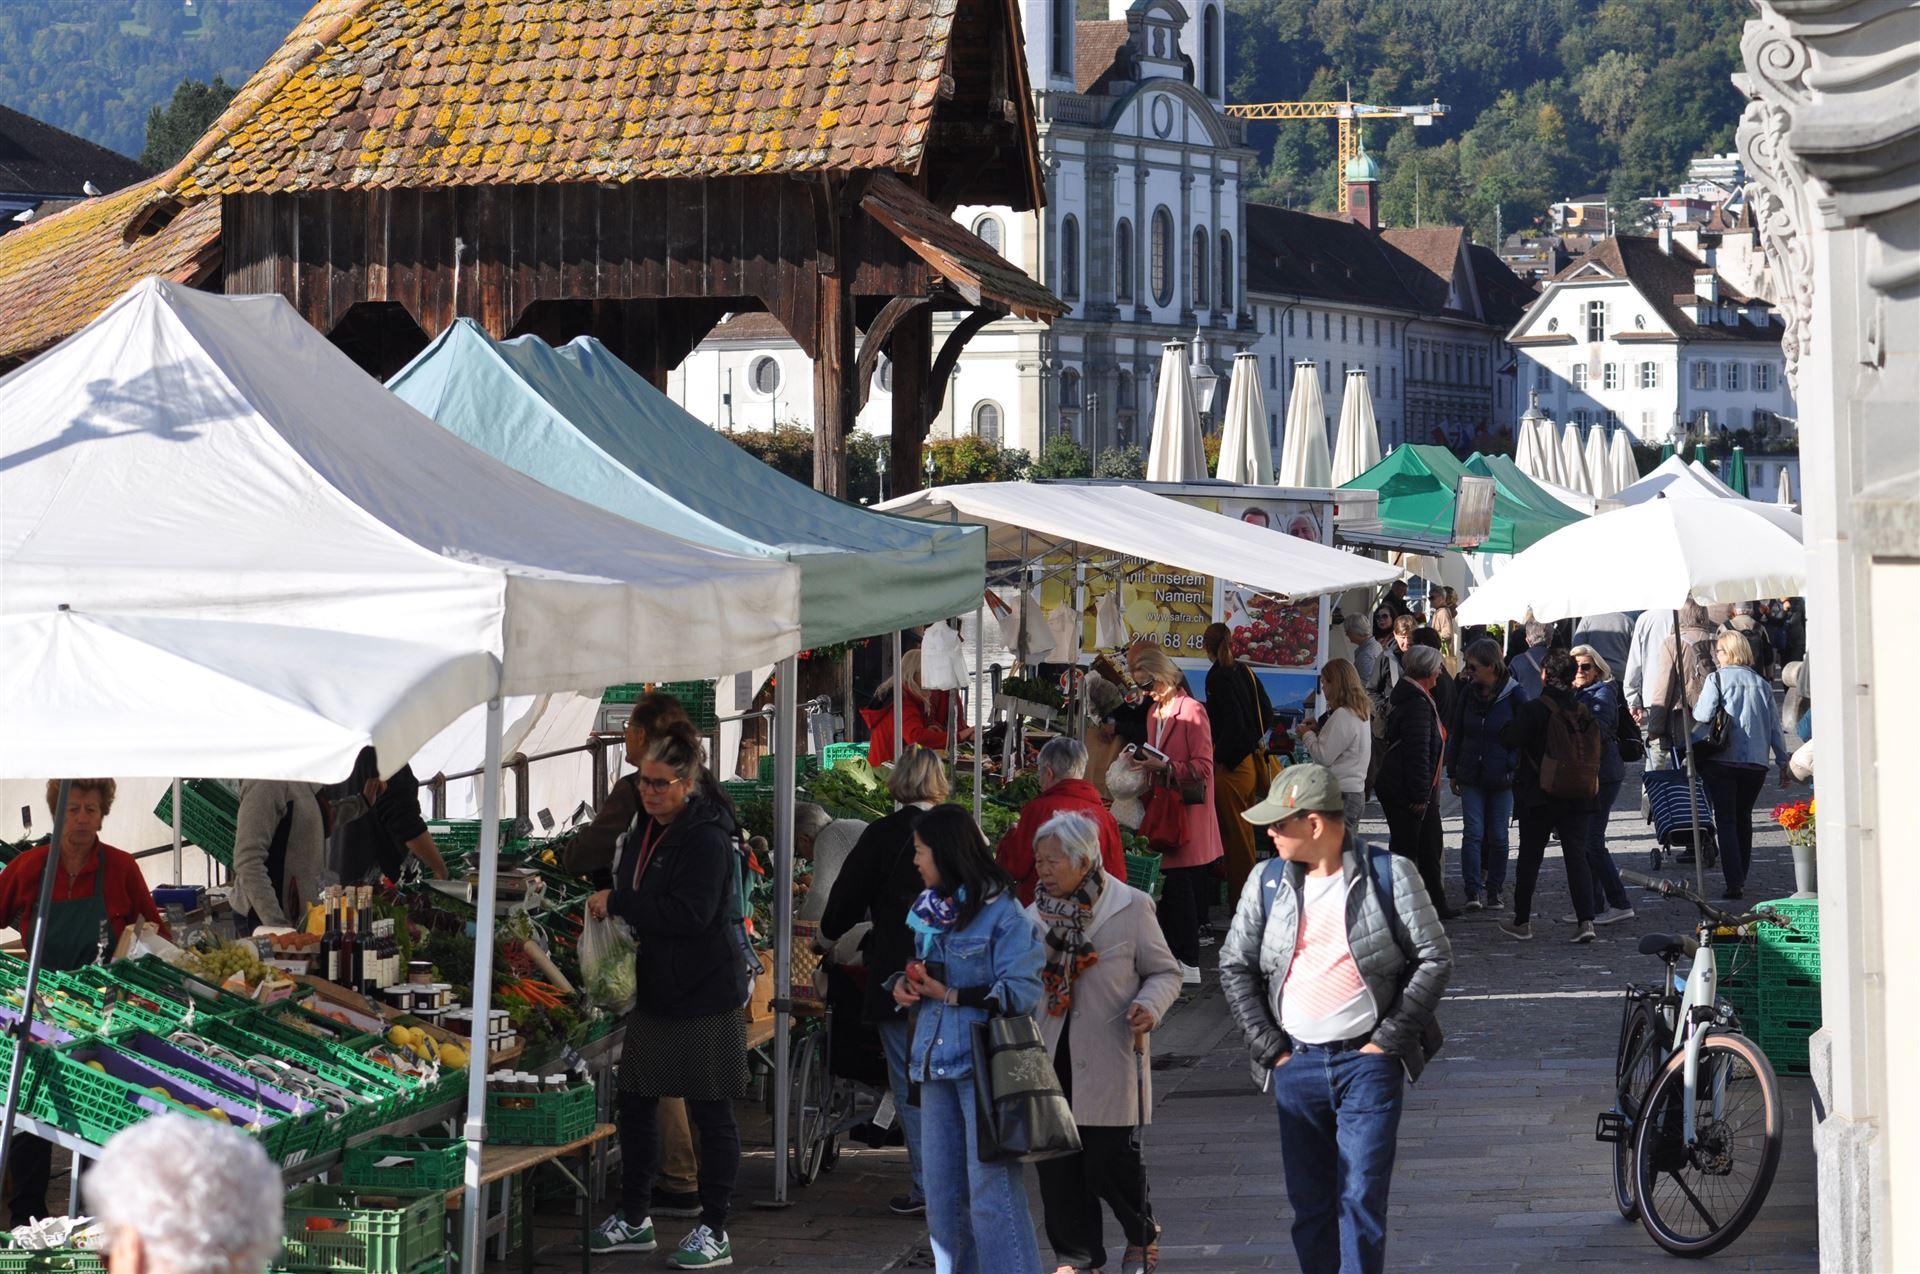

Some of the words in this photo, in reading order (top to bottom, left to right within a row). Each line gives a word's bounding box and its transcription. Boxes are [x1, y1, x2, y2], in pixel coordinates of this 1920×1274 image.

[1150, 573, 1206, 586] unserem
[1155, 588, 1205, 603] Namen!
[1146, 612, 1204, 623] www.safra.ch
[1163, 633, 1181, 648] 68
[1186, 634, 1204, 649] 48
